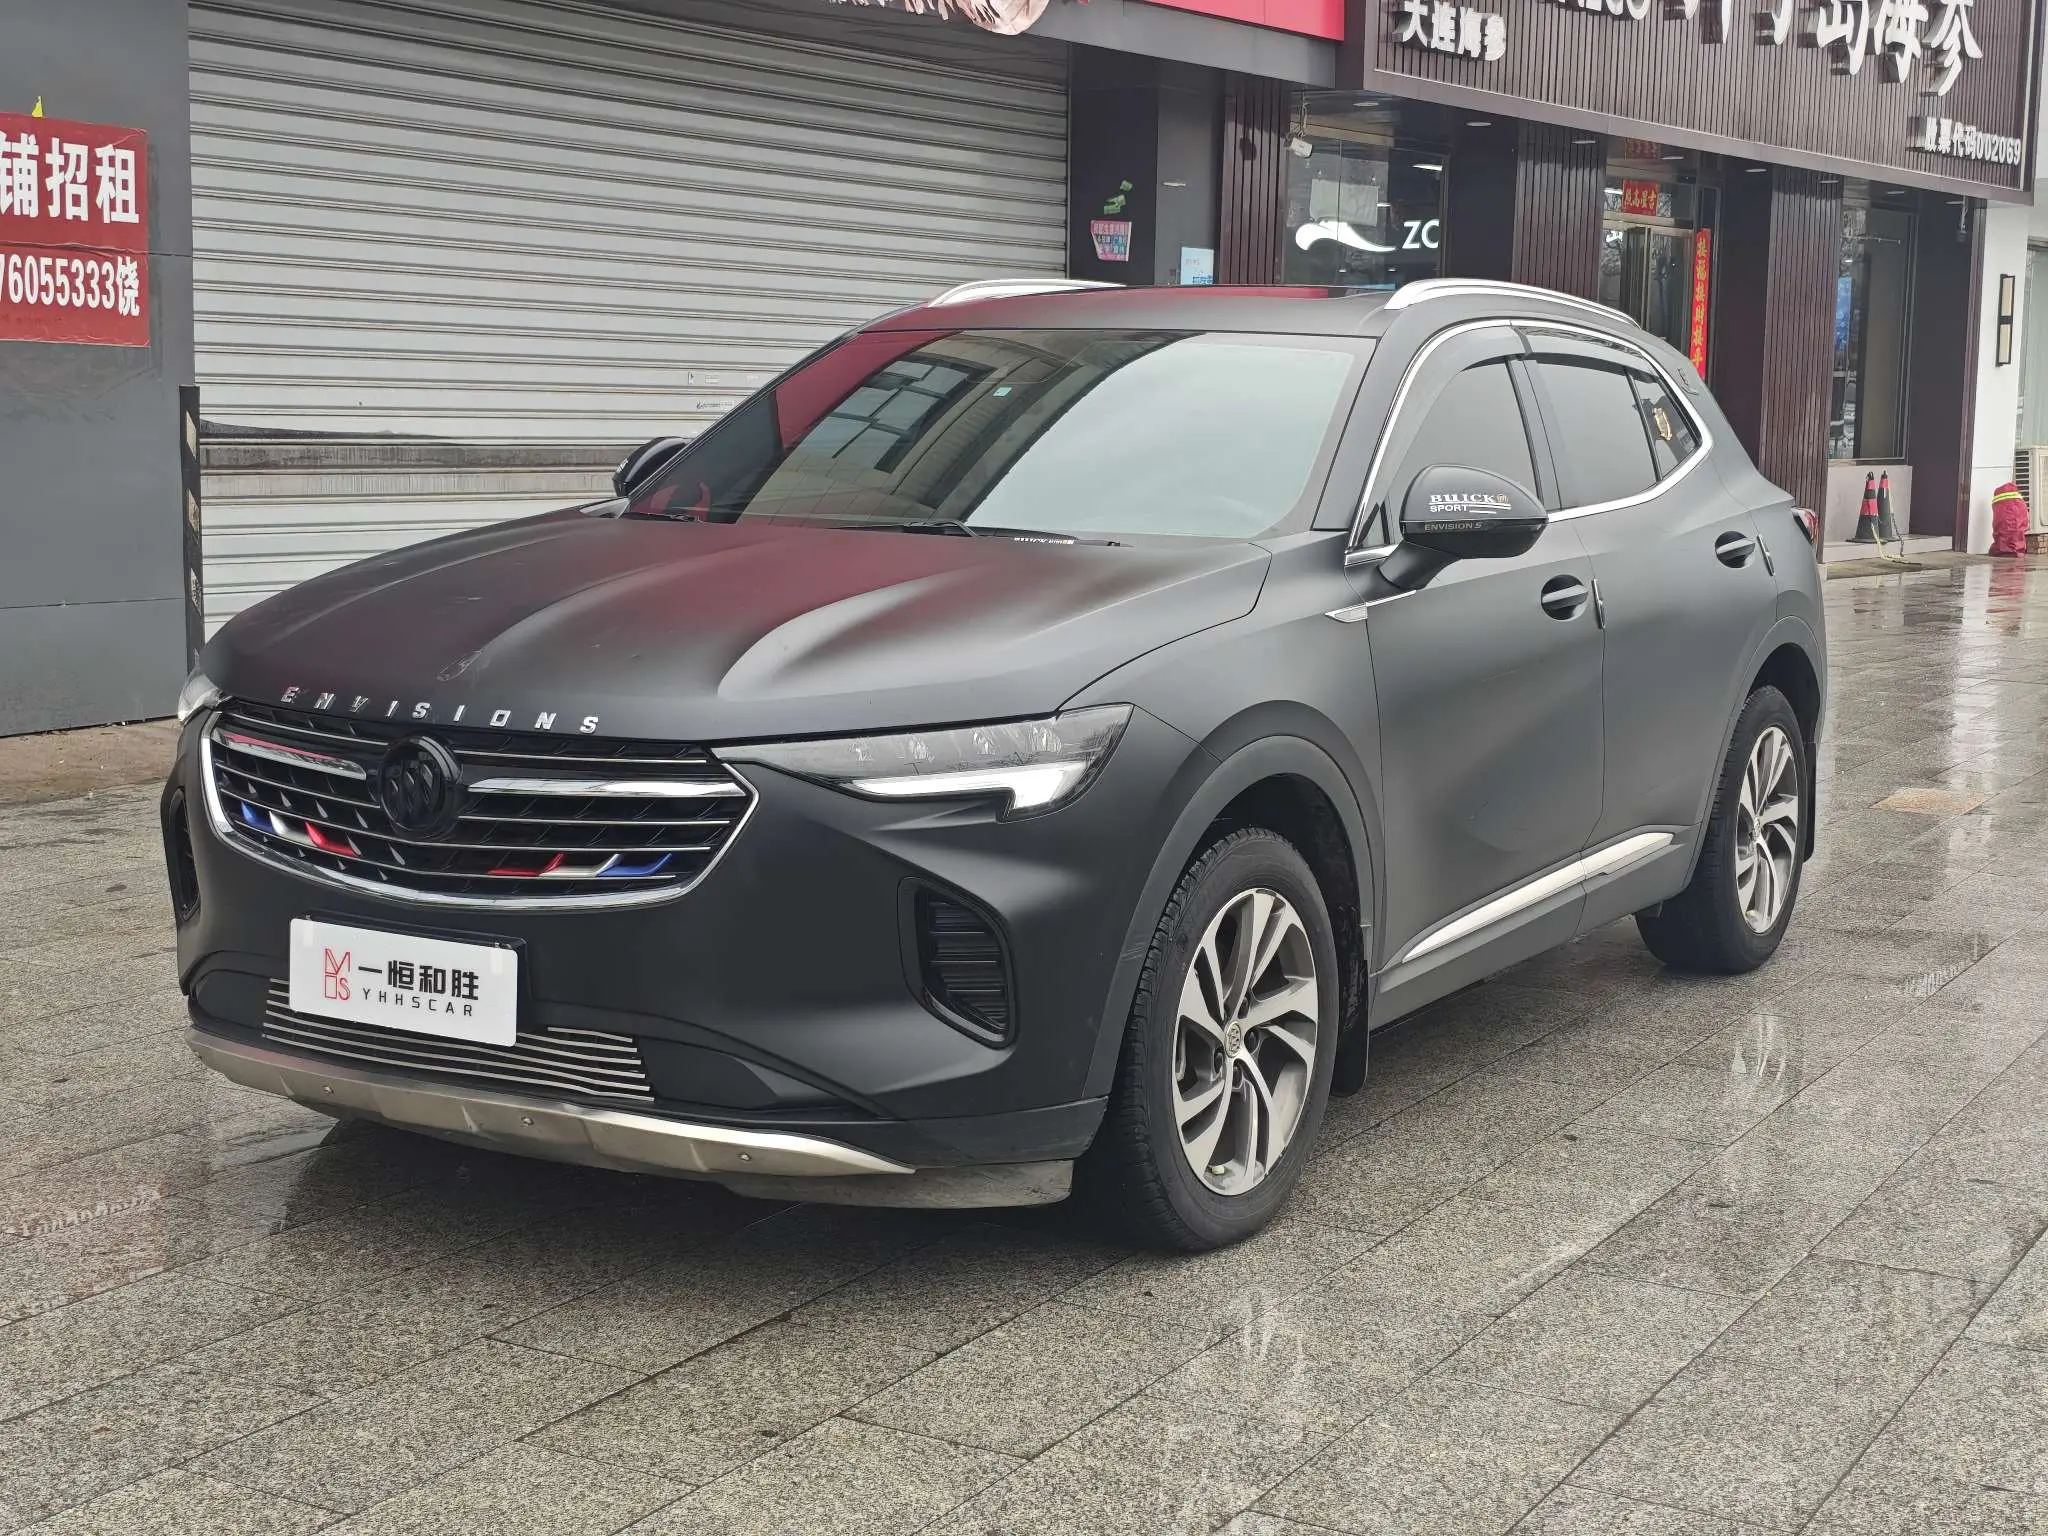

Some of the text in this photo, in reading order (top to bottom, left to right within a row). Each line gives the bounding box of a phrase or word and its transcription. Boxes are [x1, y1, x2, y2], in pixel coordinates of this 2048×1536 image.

[1429, 494, 1494, 503] BUICK
[1430, 504, 1469, 513] SPORT
[1424, 522, 1473, 531] ENVISION
[280, 686, 599, 735] ENVISIONS
[358, 959, 480, 1001] 一恒和胜
[362, 987, 473, 1017] YHHSCAR
